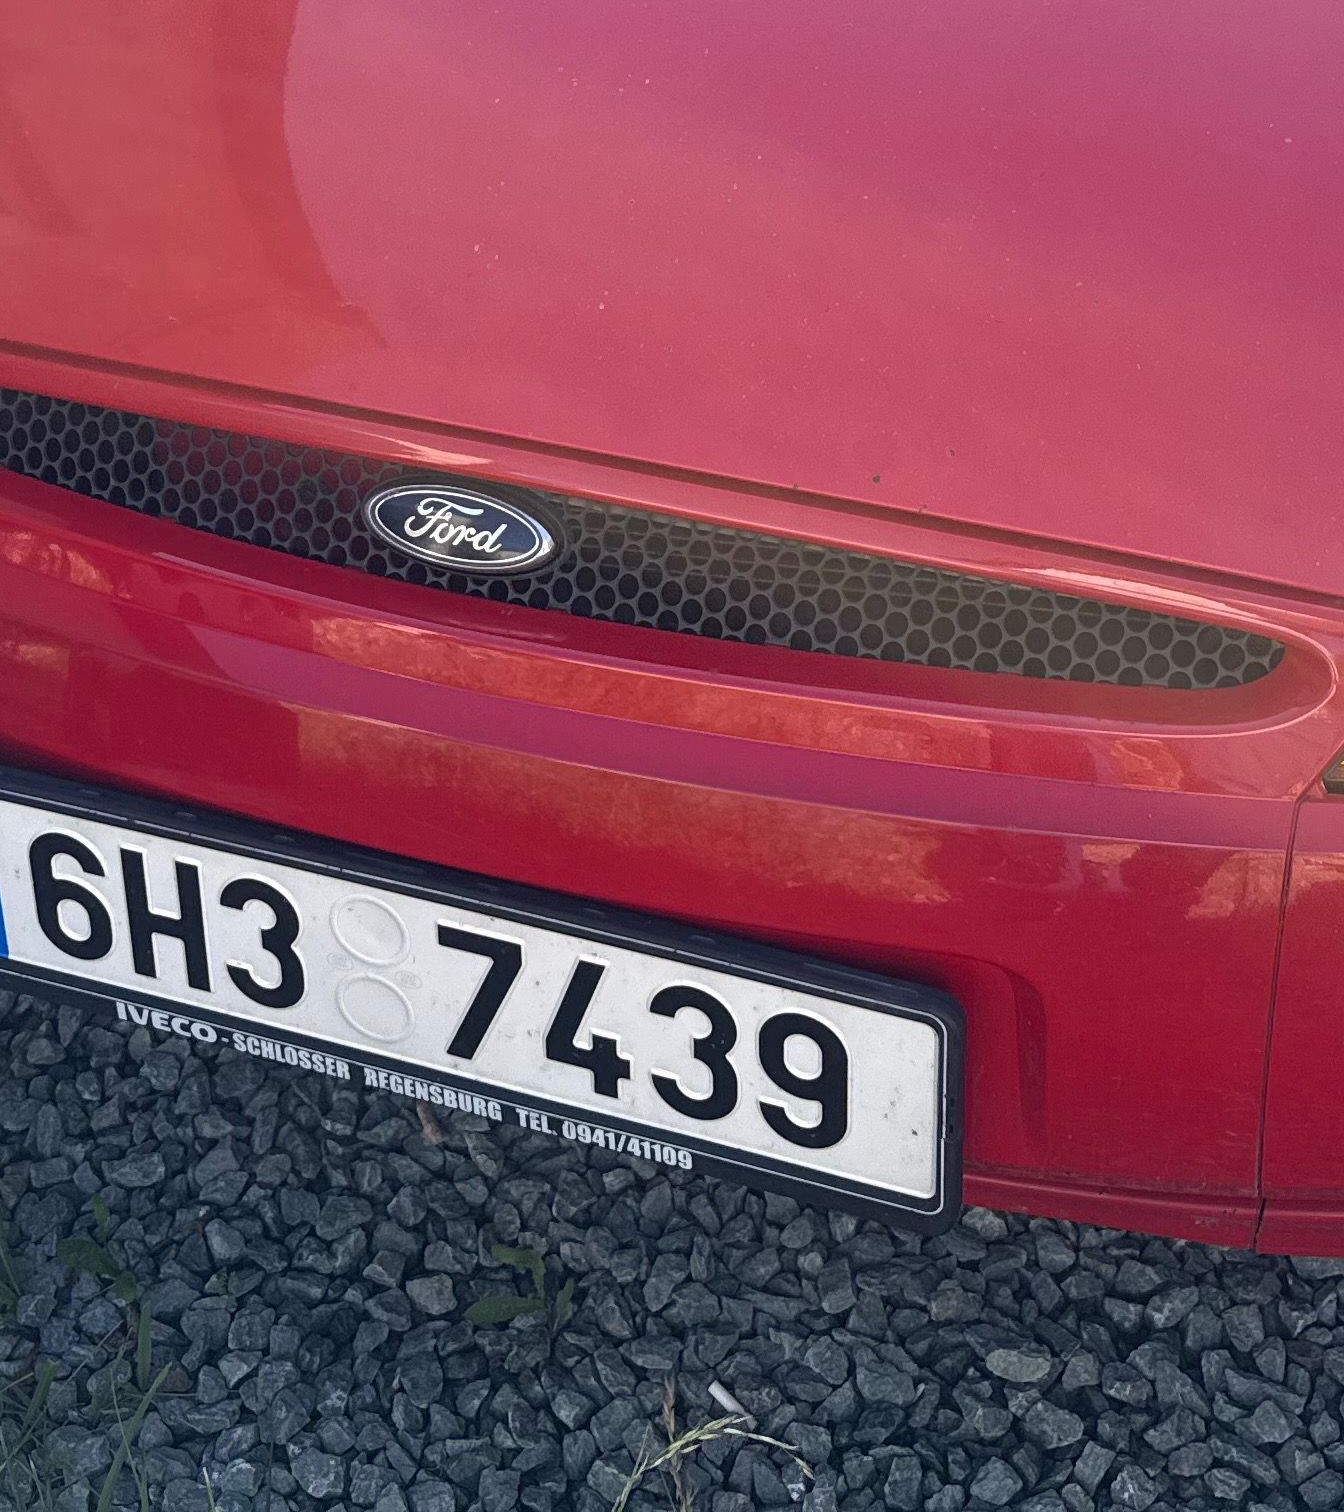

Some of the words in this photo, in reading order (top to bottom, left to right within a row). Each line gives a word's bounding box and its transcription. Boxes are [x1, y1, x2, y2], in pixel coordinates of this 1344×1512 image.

[404, 497, 508, 554] Ford
[28, 831, 307, 1009] 6H3
[437, 919, 849, 1150] 7439
[363, 1067, 503, 1122] REGENSBURG
[515, 1107, 558, 1136] TEL.
